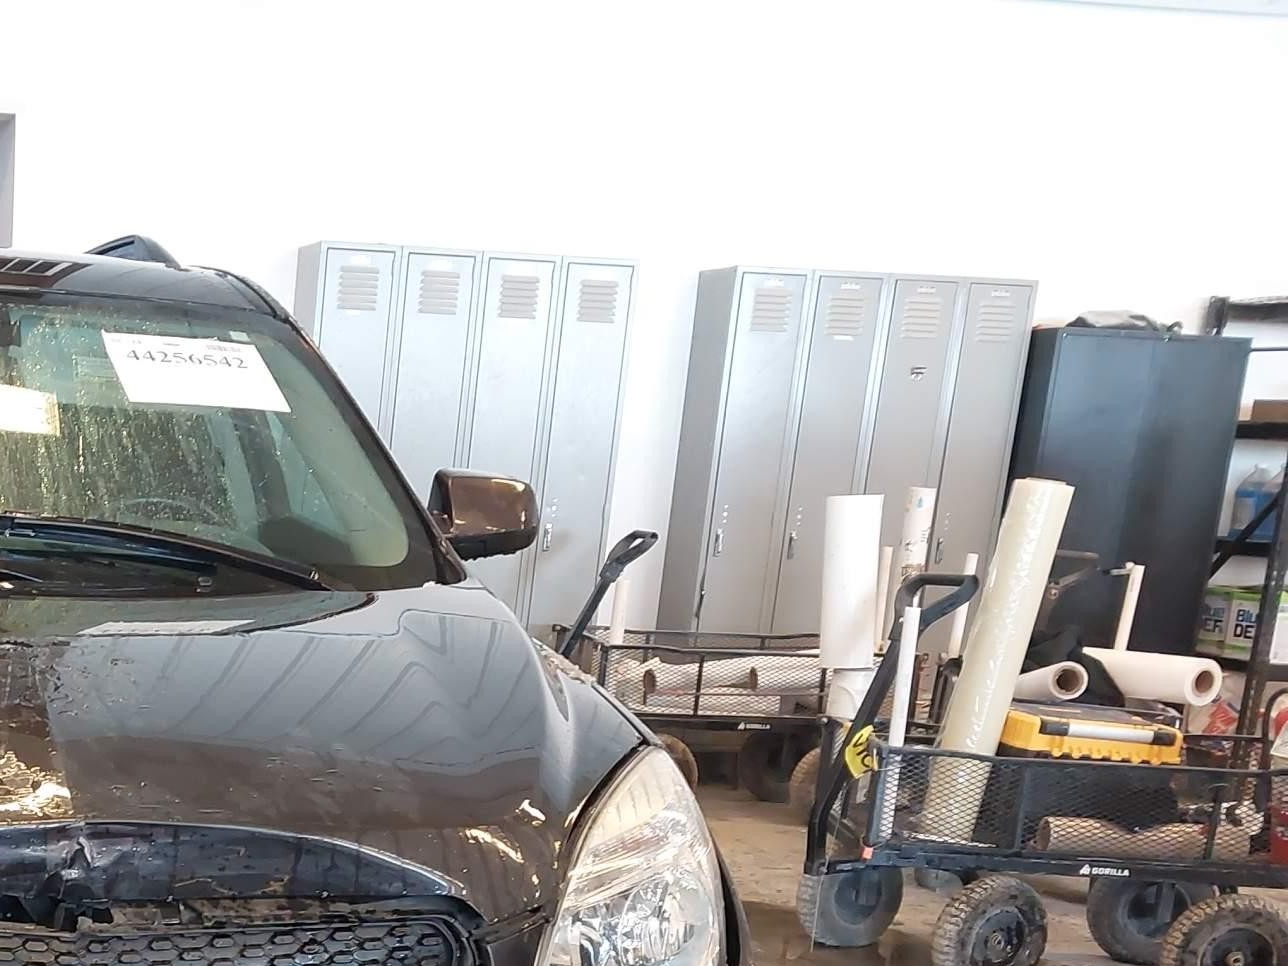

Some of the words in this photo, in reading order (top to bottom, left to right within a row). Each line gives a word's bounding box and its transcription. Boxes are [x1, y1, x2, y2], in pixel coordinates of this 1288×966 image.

[126, 349, 248, 369] 44256542
[1233, 624, 1255, 639] DE
[1092, 867, 1130, 877] GORILLA
